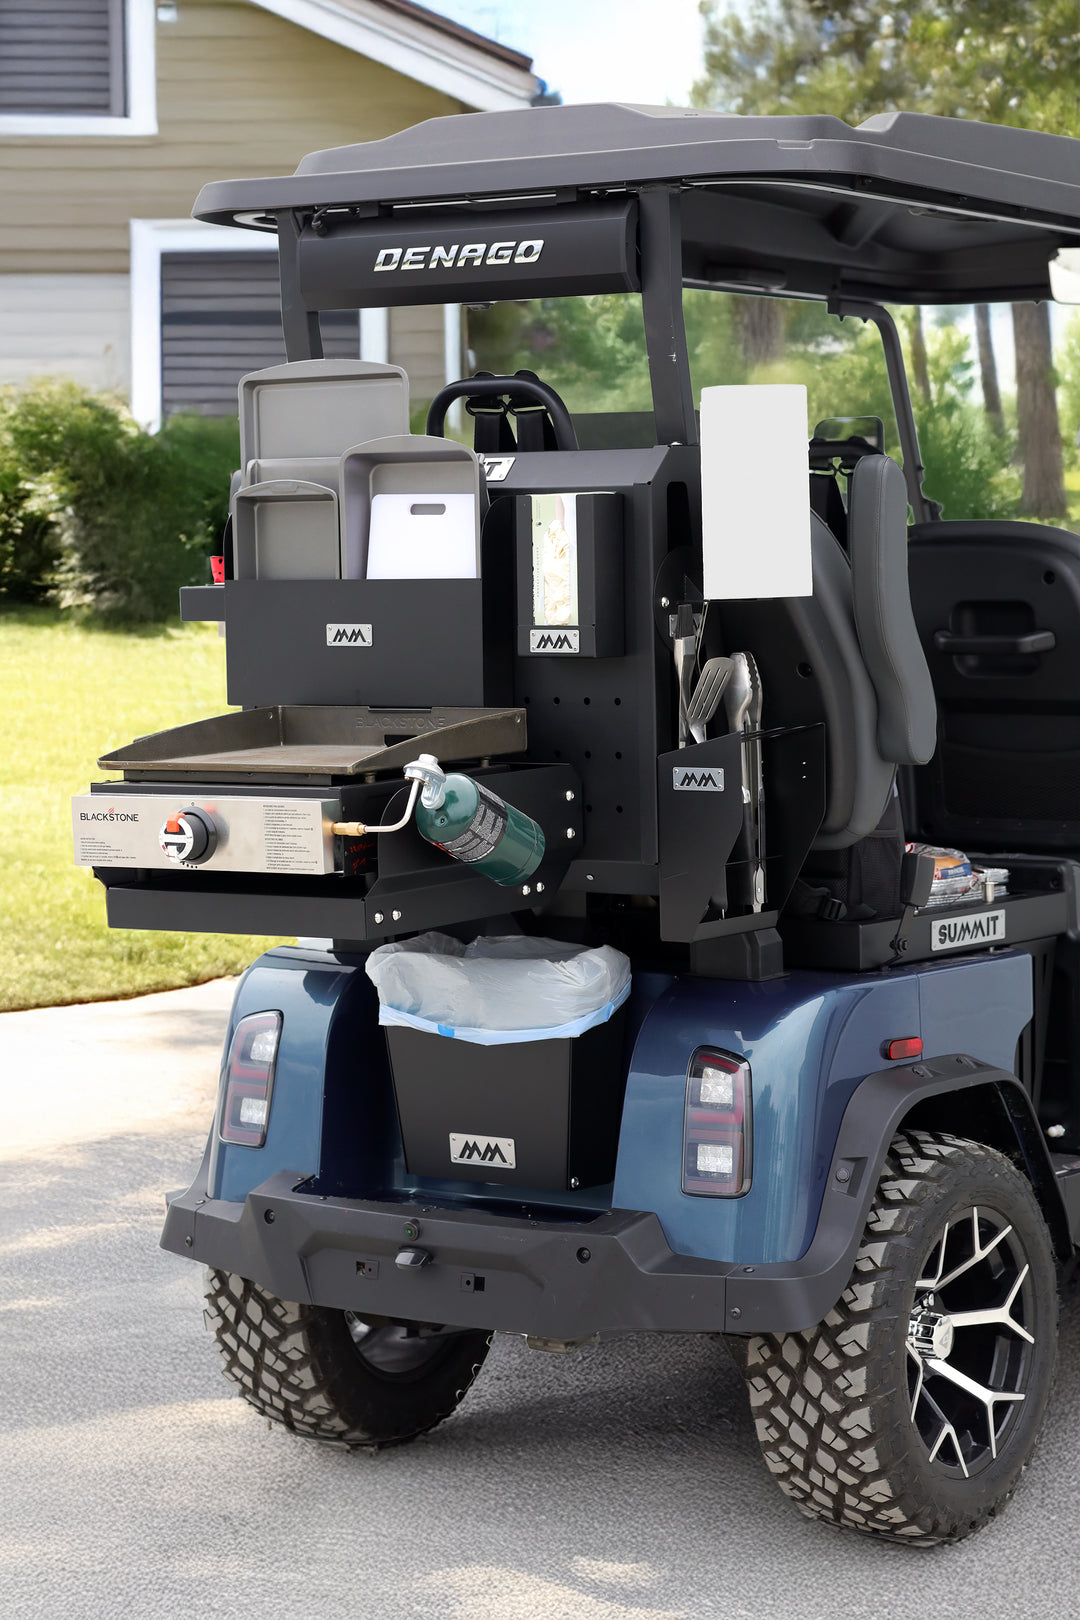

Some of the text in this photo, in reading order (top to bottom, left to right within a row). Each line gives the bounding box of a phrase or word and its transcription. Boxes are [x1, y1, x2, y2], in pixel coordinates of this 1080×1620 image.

[373, 240, 544, 272] DENAGO
[355, 717, 446, 729] BLACKSTONE
[79, 812, 140, 822] BLACKSTONE
[938, 915, 999, 945] SUMMIT
